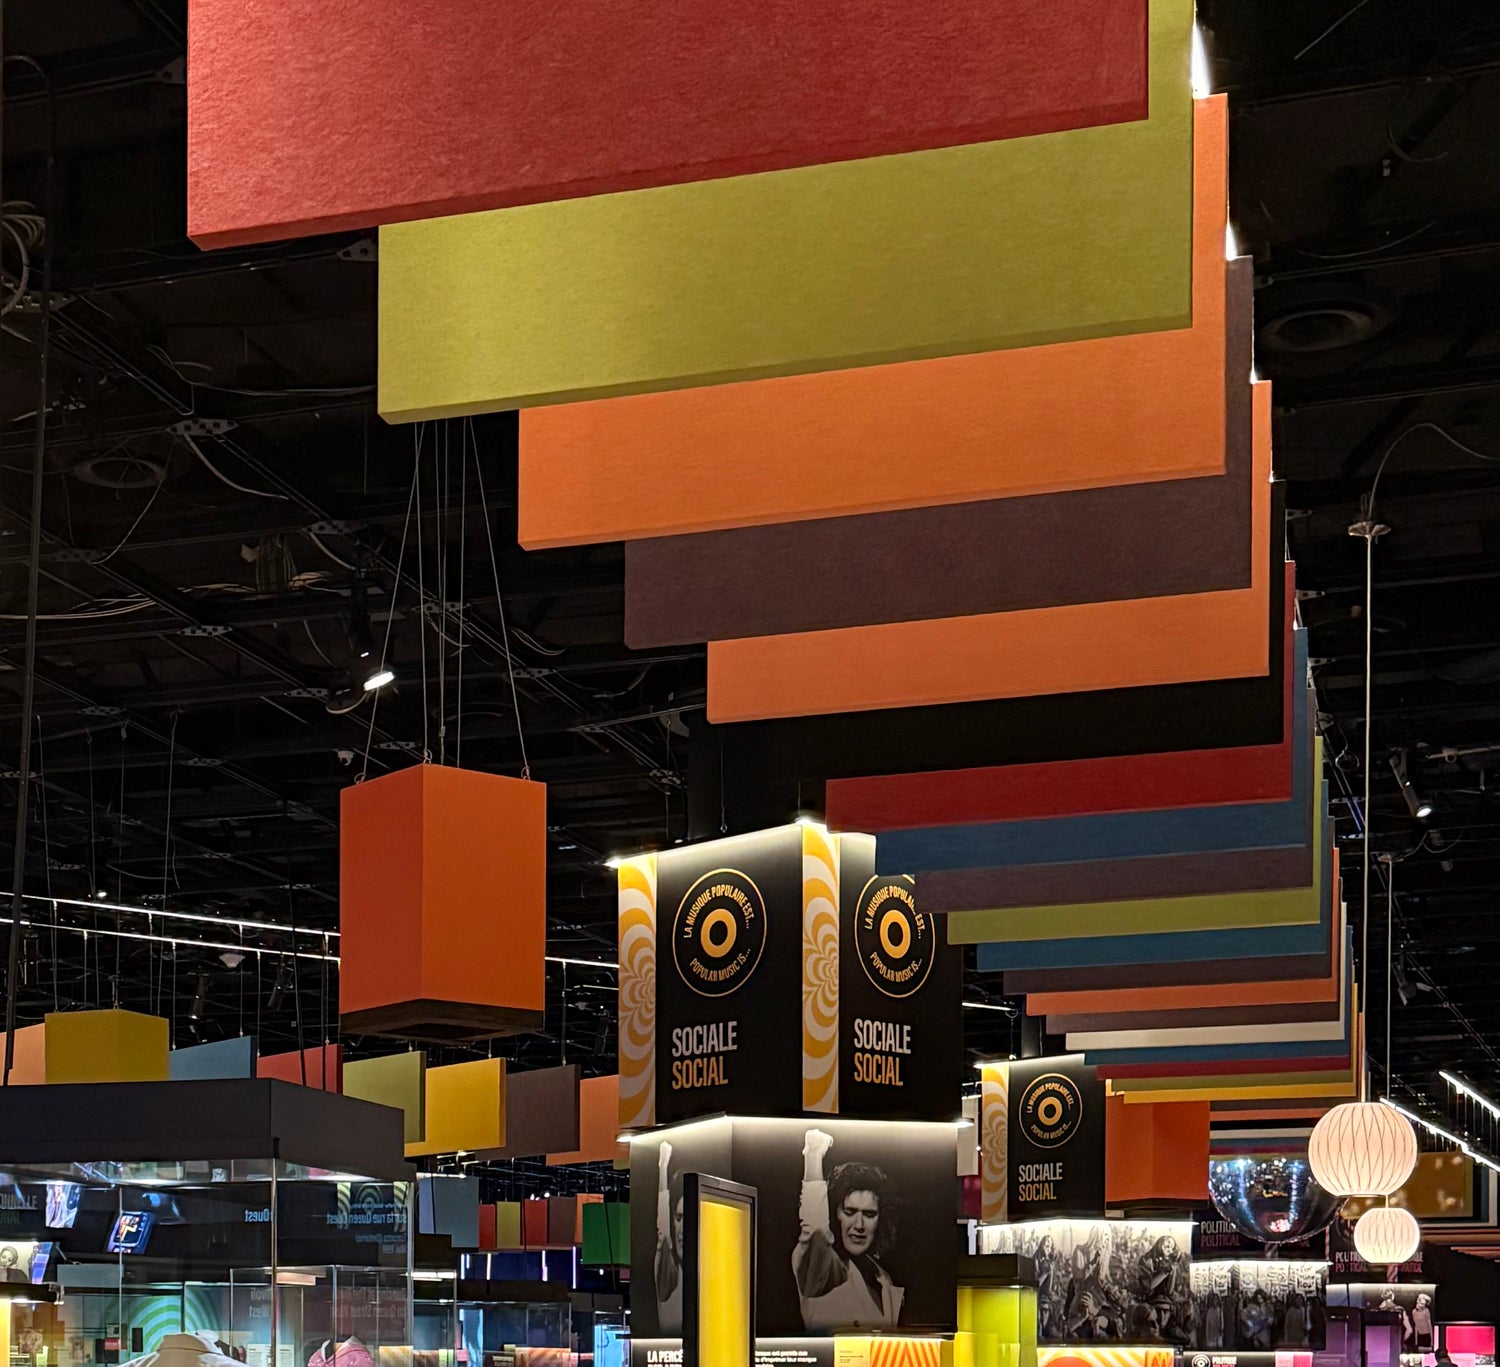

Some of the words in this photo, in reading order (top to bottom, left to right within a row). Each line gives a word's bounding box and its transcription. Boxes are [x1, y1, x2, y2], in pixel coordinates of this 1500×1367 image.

[685, 888, 712, 926] MUSIQUE
[711, 884, 748, 907] POPULAIRE
[866, 886, 890, 918] MUSIQUE
[683, 926, 693, 938] LA
[864, 919, 873, 930] LA
[689, 957, 718, 982] POPULAR
[718, 960, 741, 981] MUSIC
[869, 951, 895, 981] POPULAR
[895, 967, 914, 982] MUSIC
[671, 1021, 738, 1057] SOCIALE
[854, 1018, 912, 1054] SOCIALE
[671, 1055, 729, 1090] SOCIAL
[853, 1051, 904, 1086] SOCIAL
[1018, 1162, 1063, 1183] SOCIALE
[1018, 1182, 1057, 1202] SOCIAL
[647, 1350, 658, 1363] LA
